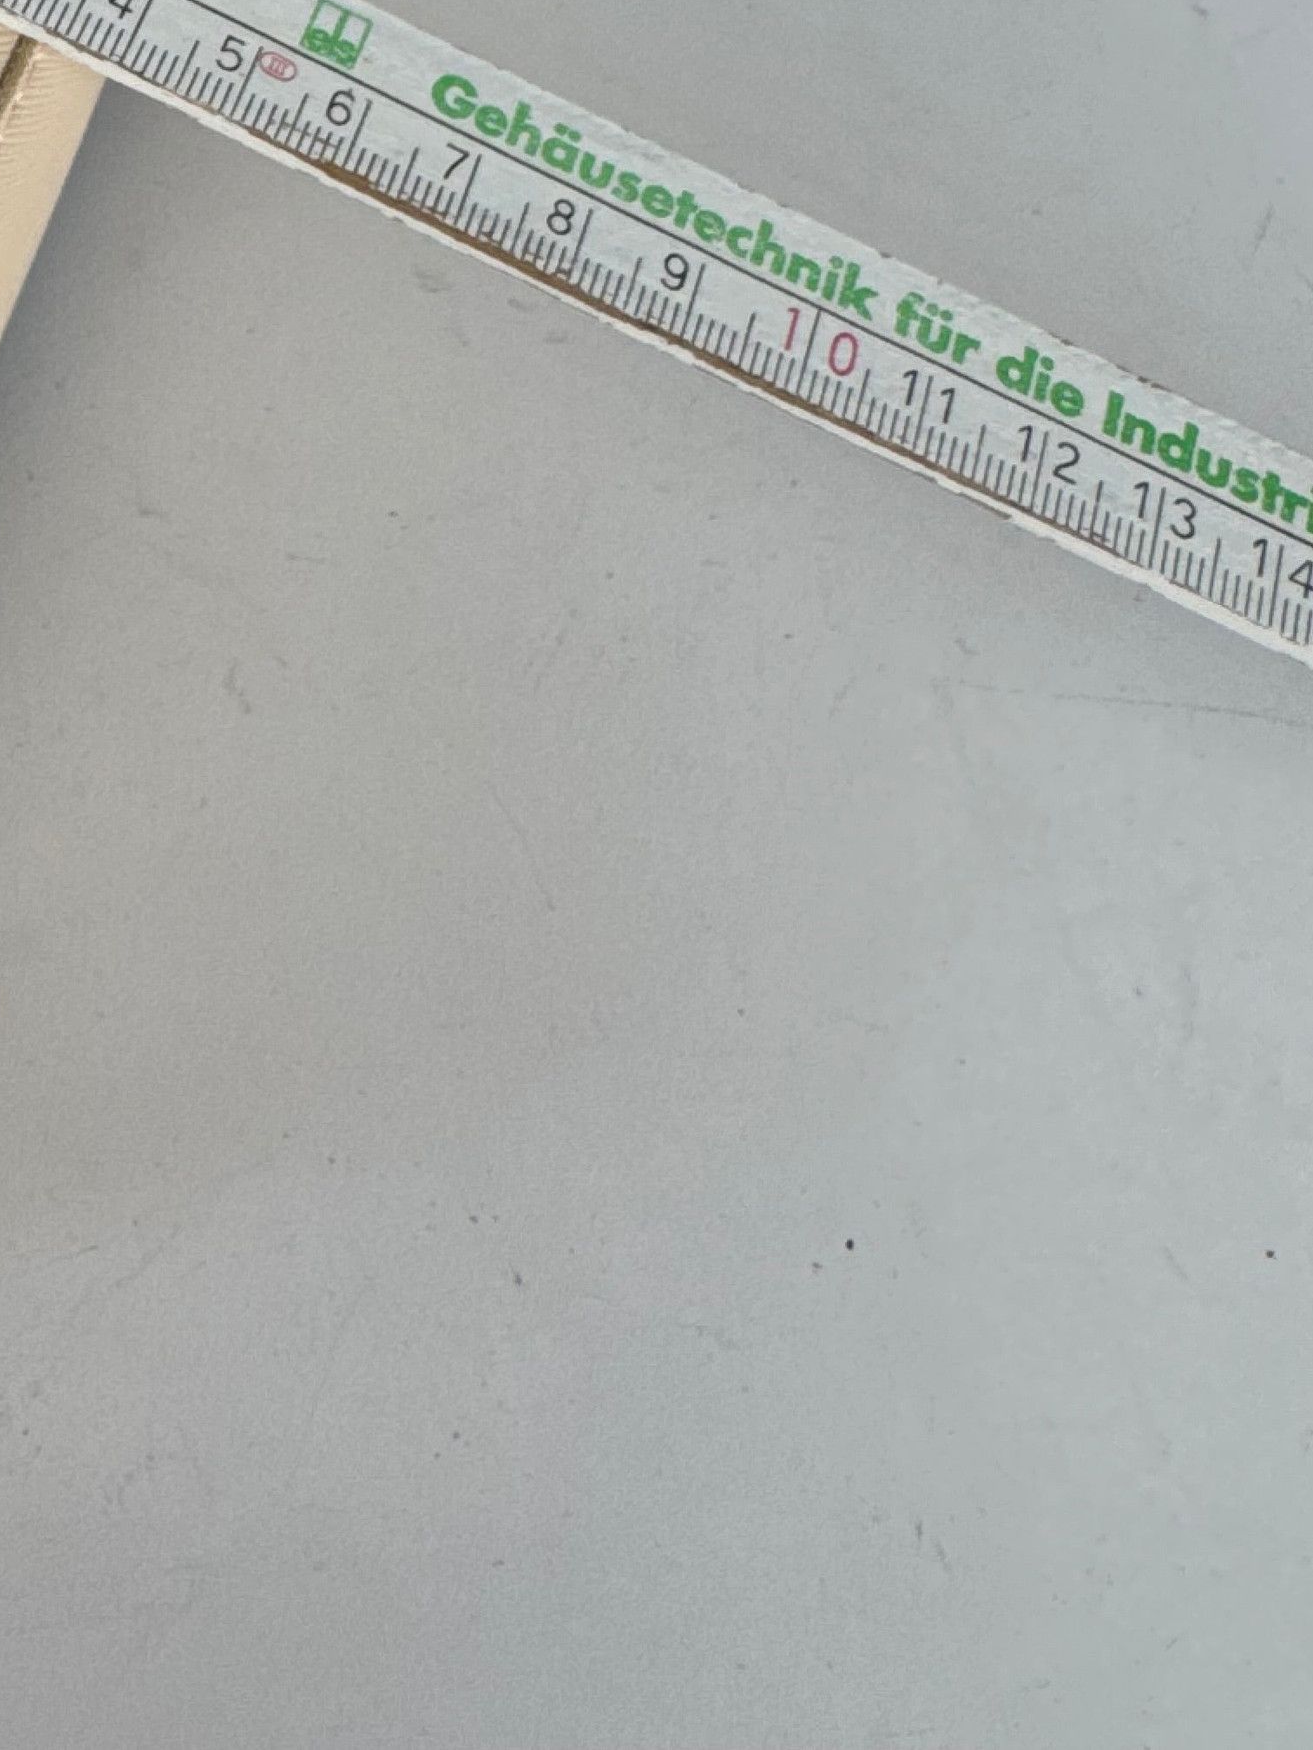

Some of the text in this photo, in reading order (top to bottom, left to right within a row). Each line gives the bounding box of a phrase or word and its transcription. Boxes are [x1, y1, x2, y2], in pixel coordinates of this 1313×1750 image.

[215, 35, 245, 72] 5
[325, 88, 355, 126] 6
[443, 142, 469, 180] 7
[546, 199, 576, 235] 8
[660, 253, 689, 291] 9
[431, 74, 879, 321] Gehäusetechnik
[894, 291, 981, 364] für
[995, 346, 1085, 417] die
